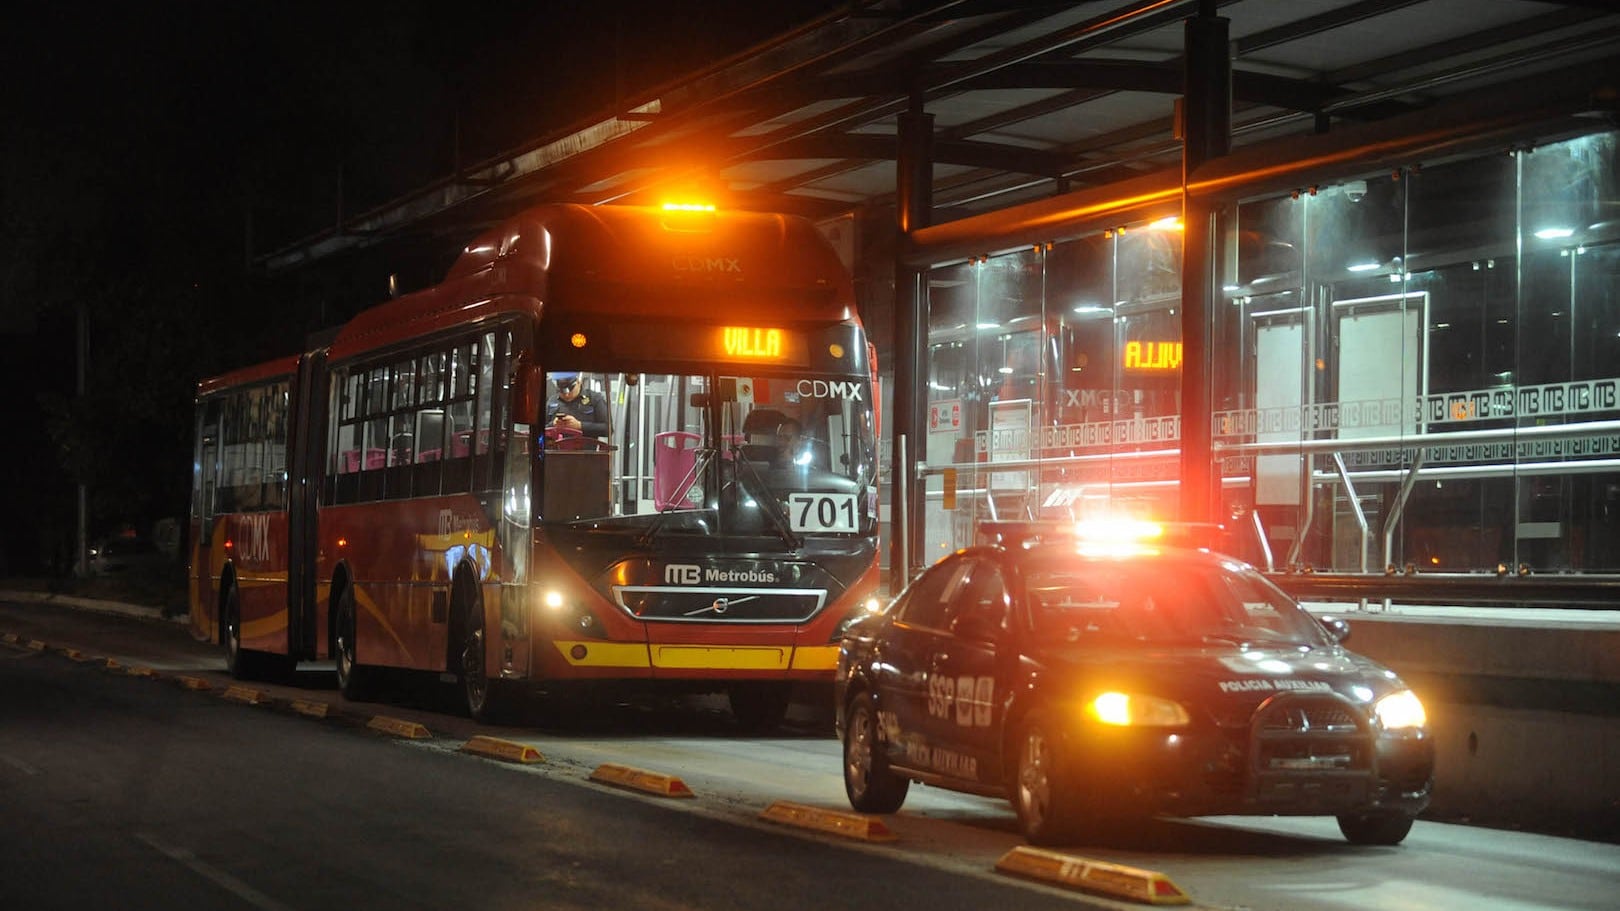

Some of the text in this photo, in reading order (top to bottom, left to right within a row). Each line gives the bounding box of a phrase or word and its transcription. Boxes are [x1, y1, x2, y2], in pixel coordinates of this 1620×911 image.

[671, 256, 741, 273] CDMX
[722, 326, 781, 357] VILLA
[796, 379, 863, 401] CDMX
[794, 497, 855, 528] 701
[238, 513, 271, 562] CDMX
[665, 564, 775, 585] MB Metrobús
[928, 672, 955, 720] SSP
[1218, 680, 1274, 693] POLICIA
